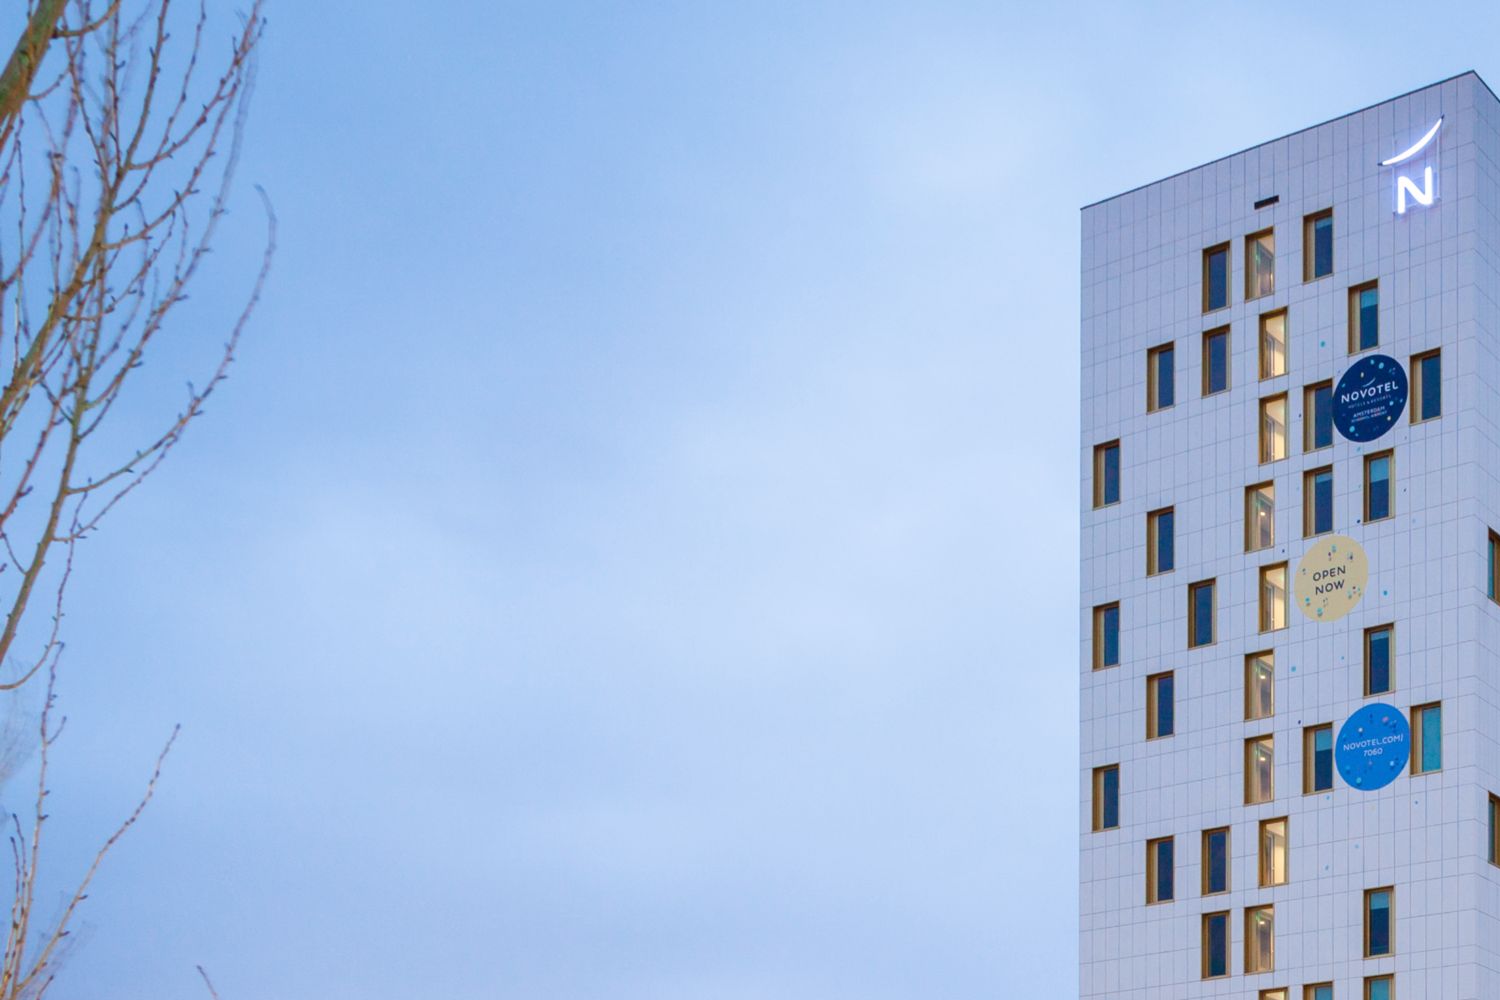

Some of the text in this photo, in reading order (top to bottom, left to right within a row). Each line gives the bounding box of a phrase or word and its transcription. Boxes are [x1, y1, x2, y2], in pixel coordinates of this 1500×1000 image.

[1397, 166, 1433, 214] N
[1341, 380, 1399, 404] NOVOTEL
[1312, 565, 1346, 581] OPEN
[1315, 579, 1345, 595] NOW
